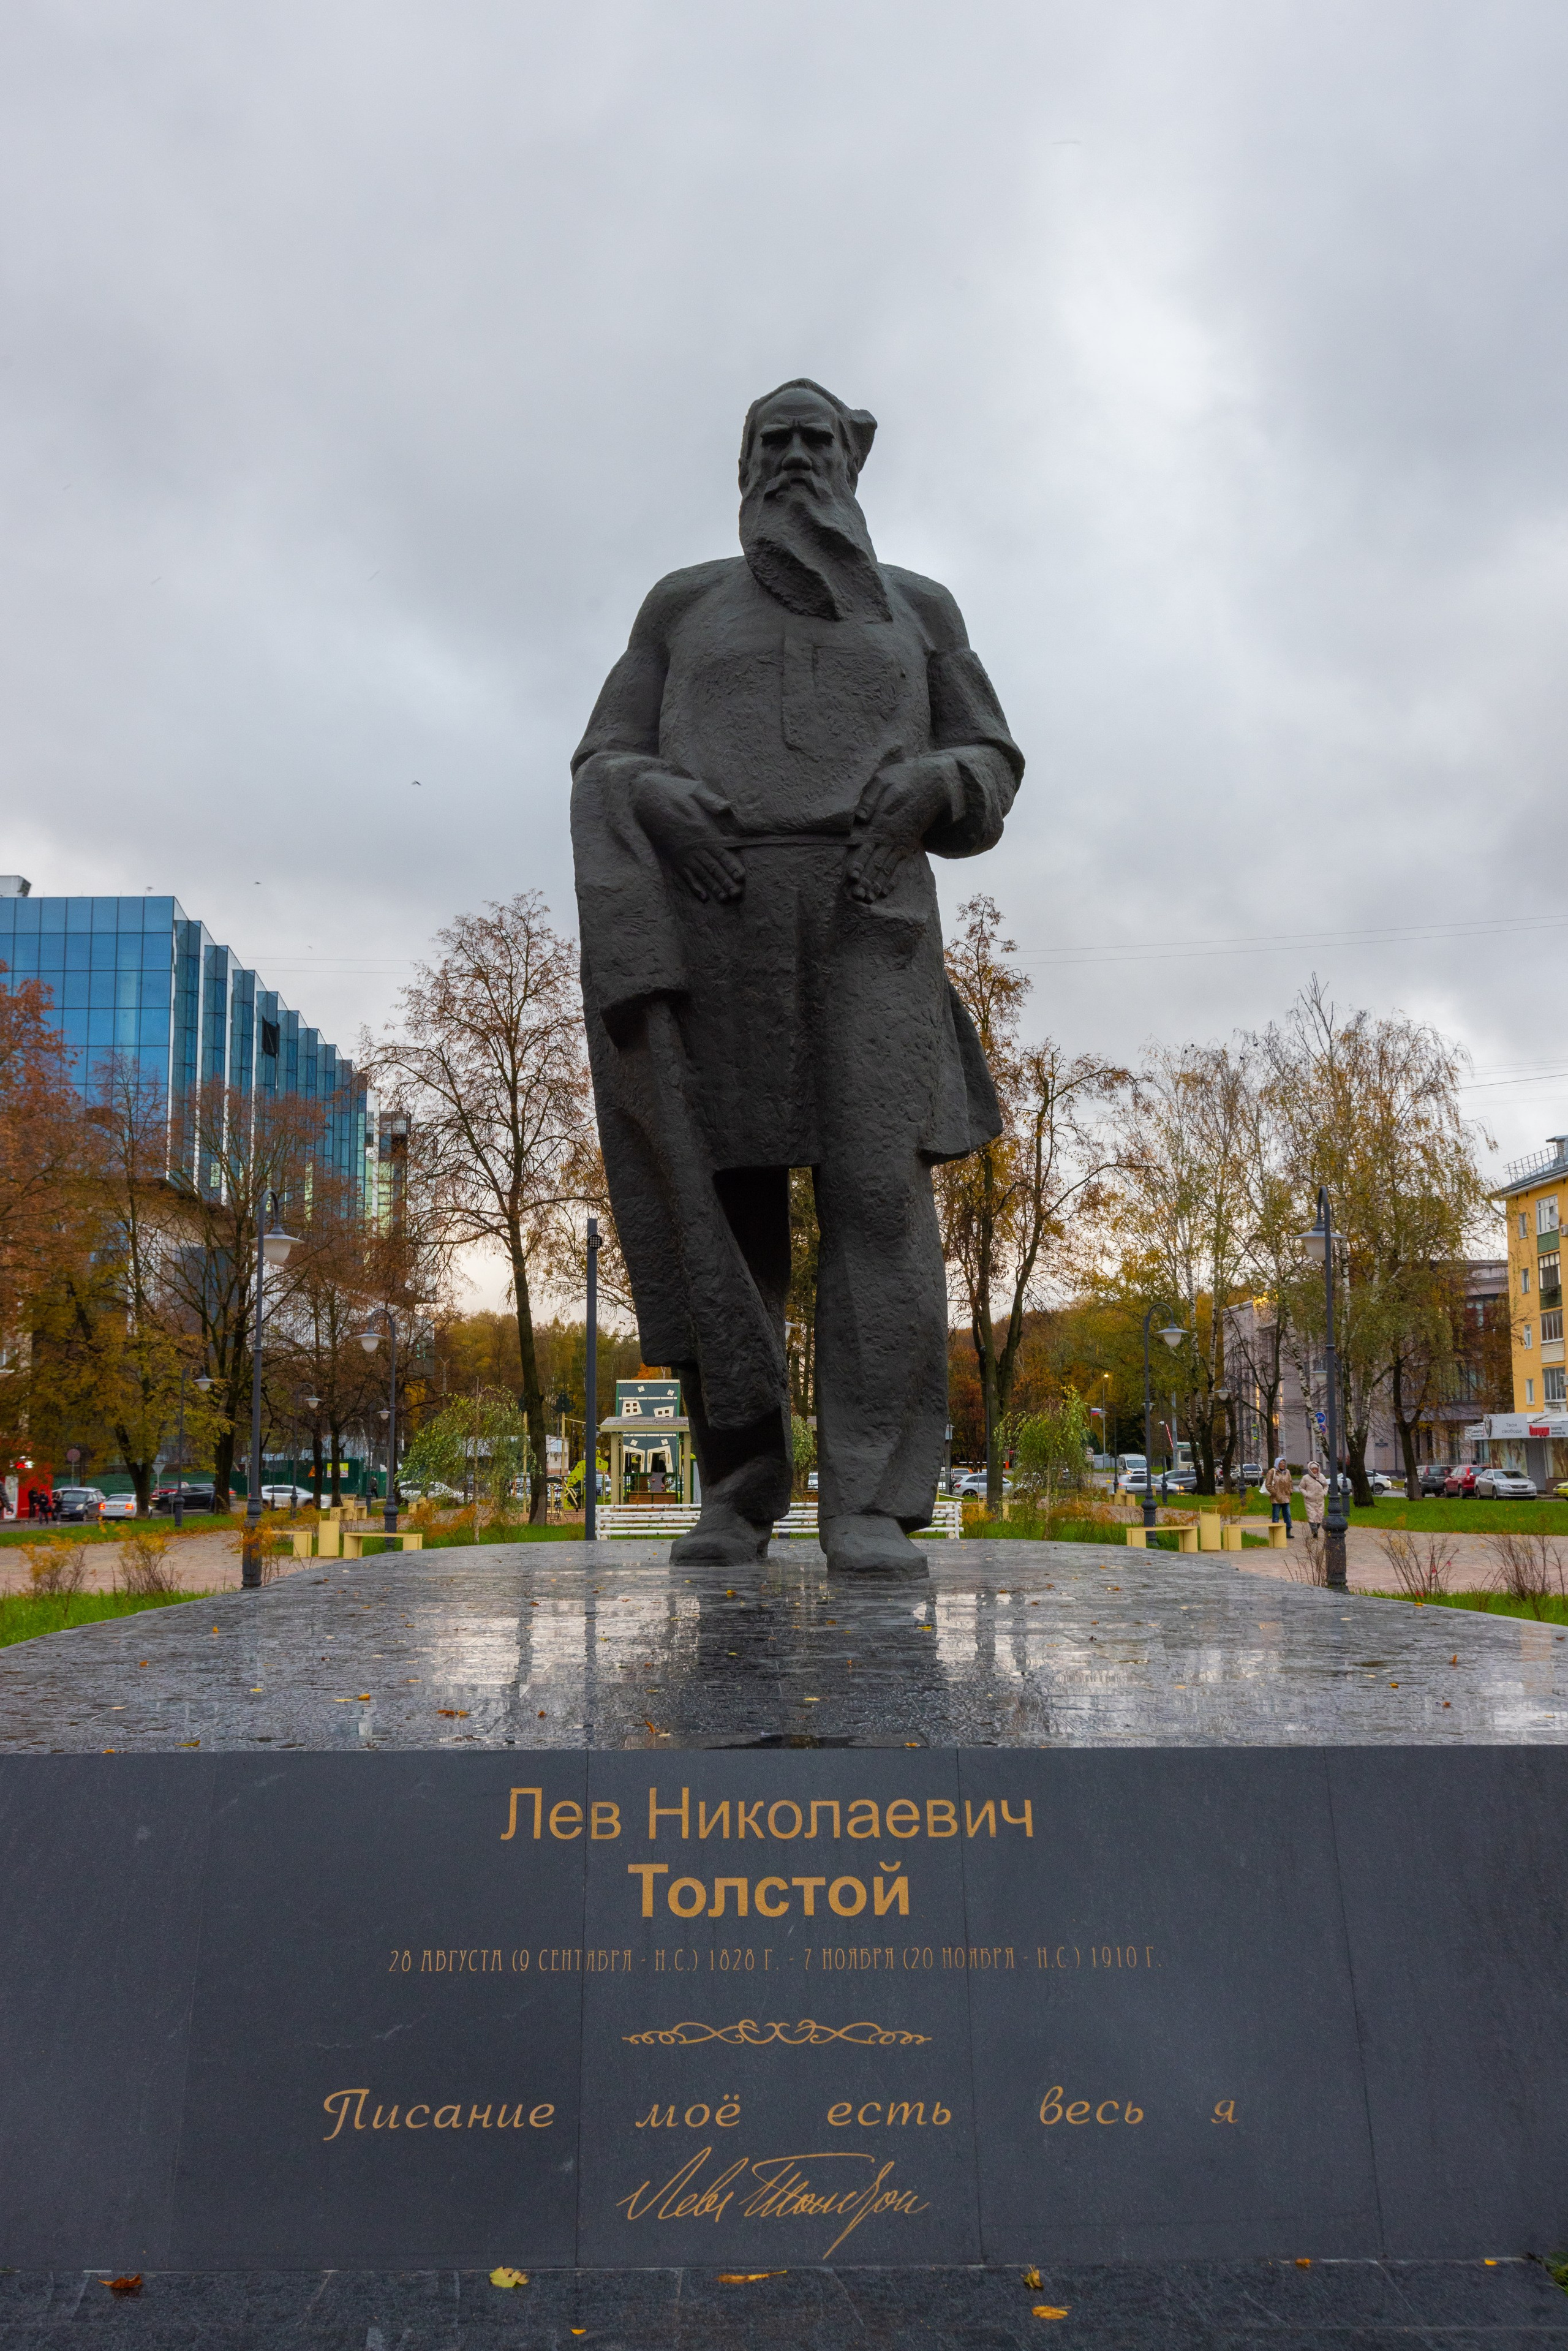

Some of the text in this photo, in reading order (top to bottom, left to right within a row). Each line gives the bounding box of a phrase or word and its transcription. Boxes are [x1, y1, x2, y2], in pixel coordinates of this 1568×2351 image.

[500, 1786, 1035, 1841] Лев Николаевич
[627, 1860, 910, 1918] Толстой
[388, 1949, 412, 1972] 28
[420, 1949, 503, 1972] АВГУСТА
[511, 1948, 530, 1972] (9
[538, 1948, 632, 1971] СЕНТЯБРЯ
[710, 1948, 755, 1971] 1828
[764, 1949, 779, 1971] Г.
[804, 1948, 812, 1971] 7
[822, 1947, 894, 1970] НОЯБРЯ
[903, 1946, 933, 1970] (20
[942, 1946, 1014, 1969] НОЯБРЯ
[1092, 1945, 1137, 1968] 1910
[1145, 1946, 1161, 1968] Г.
[323, 2085, 1238, 2141] Писание моё есть весь я
